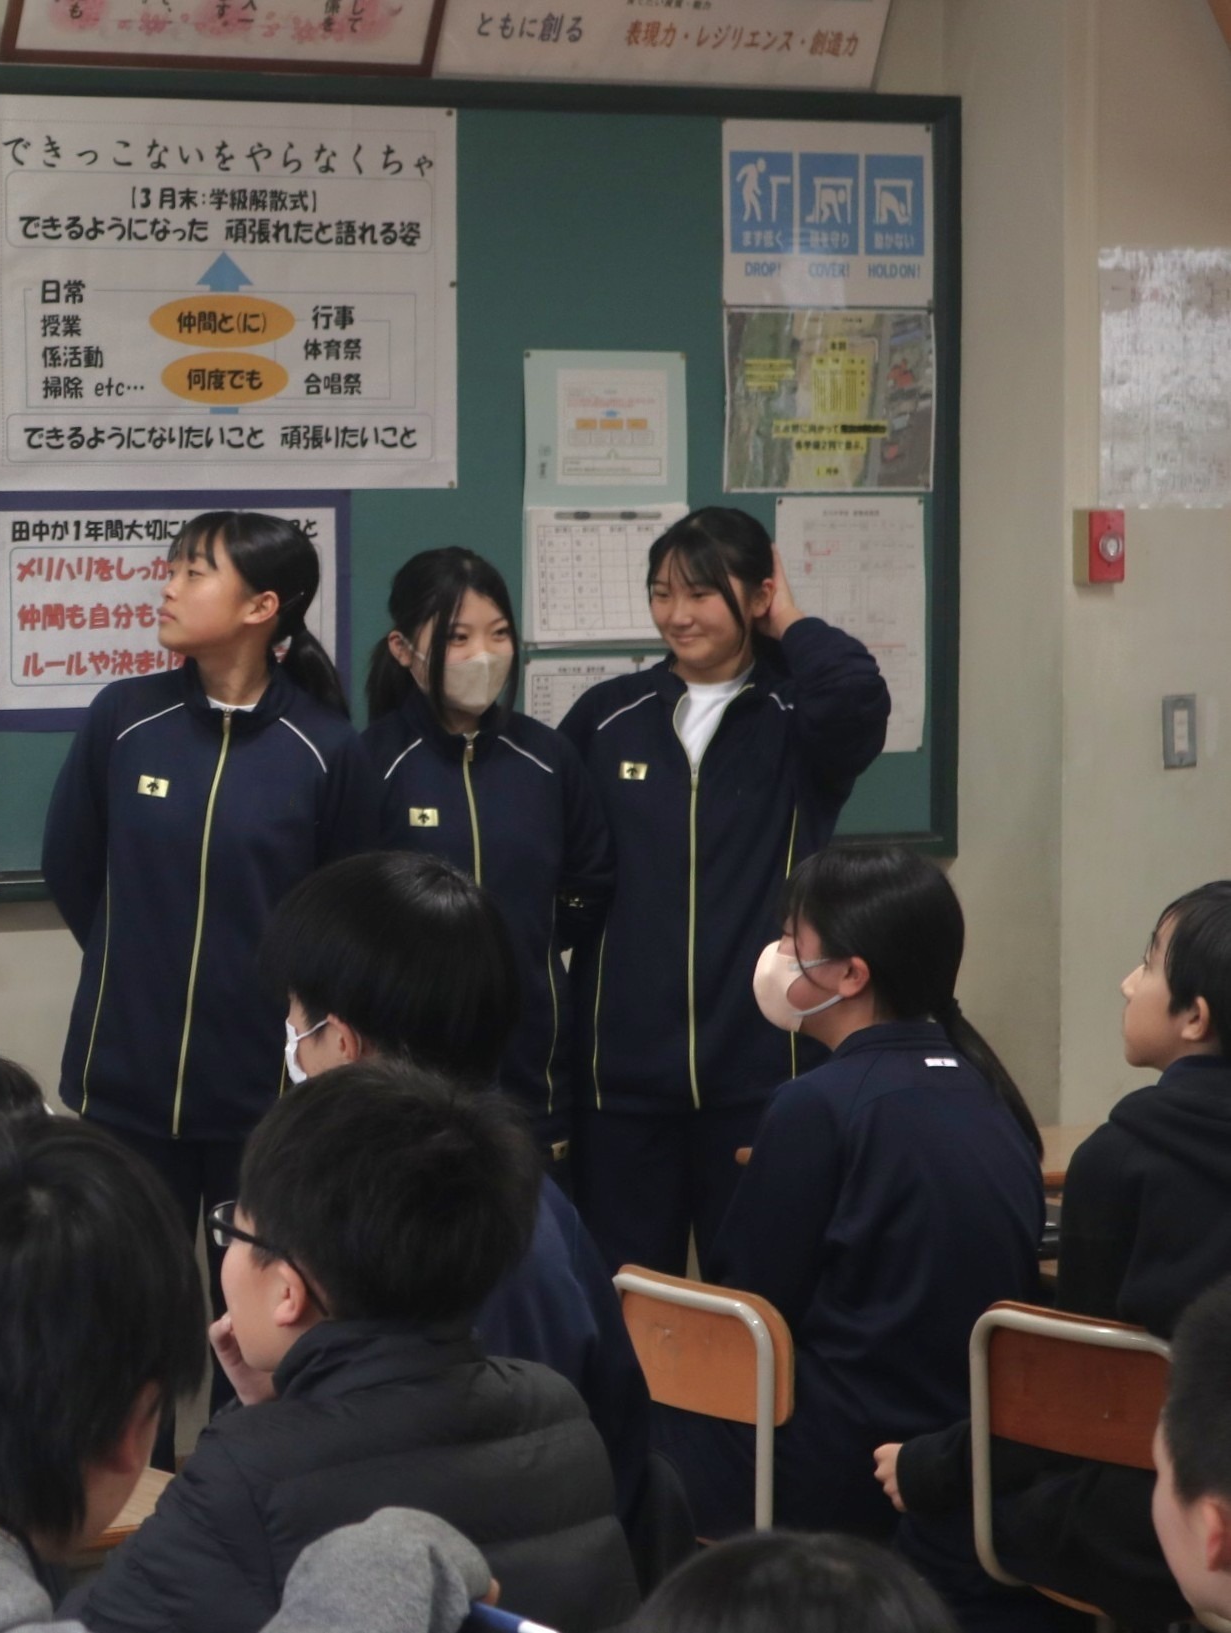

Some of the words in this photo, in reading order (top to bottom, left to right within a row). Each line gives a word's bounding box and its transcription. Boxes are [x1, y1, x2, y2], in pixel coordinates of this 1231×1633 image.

[477, 13, 583, 43] ともに創る
[625, 20, 859, 58] 表現力・レジリエンス・創造力
[2, 135, 434, 177] できっこないをやらなくちゃ
[19, 215, 209, 243] できるようになった
[225, 218, 421, 247] 頑張れたと語れる姿
[744, 261, 781, 278] DROP!
[808, 262, 851, 279] COVER!
[41, 279, 86, 305] 日常
[40, 314, 82, 338] 授業
[311, 305, 355, 331] 行事
[41, 345, 104, 369] 係活動
[303, 338, 362, 361] 体育祭
[42, 376, 84, 400] 掃除
[186, 367, 264, 392] 何度でも
[304, 372, 362, 396] 合唱祭
[23, 425, 265, 450] できるようになりたいこと
[280, 424, 417, 450] 頑張りたいこと
